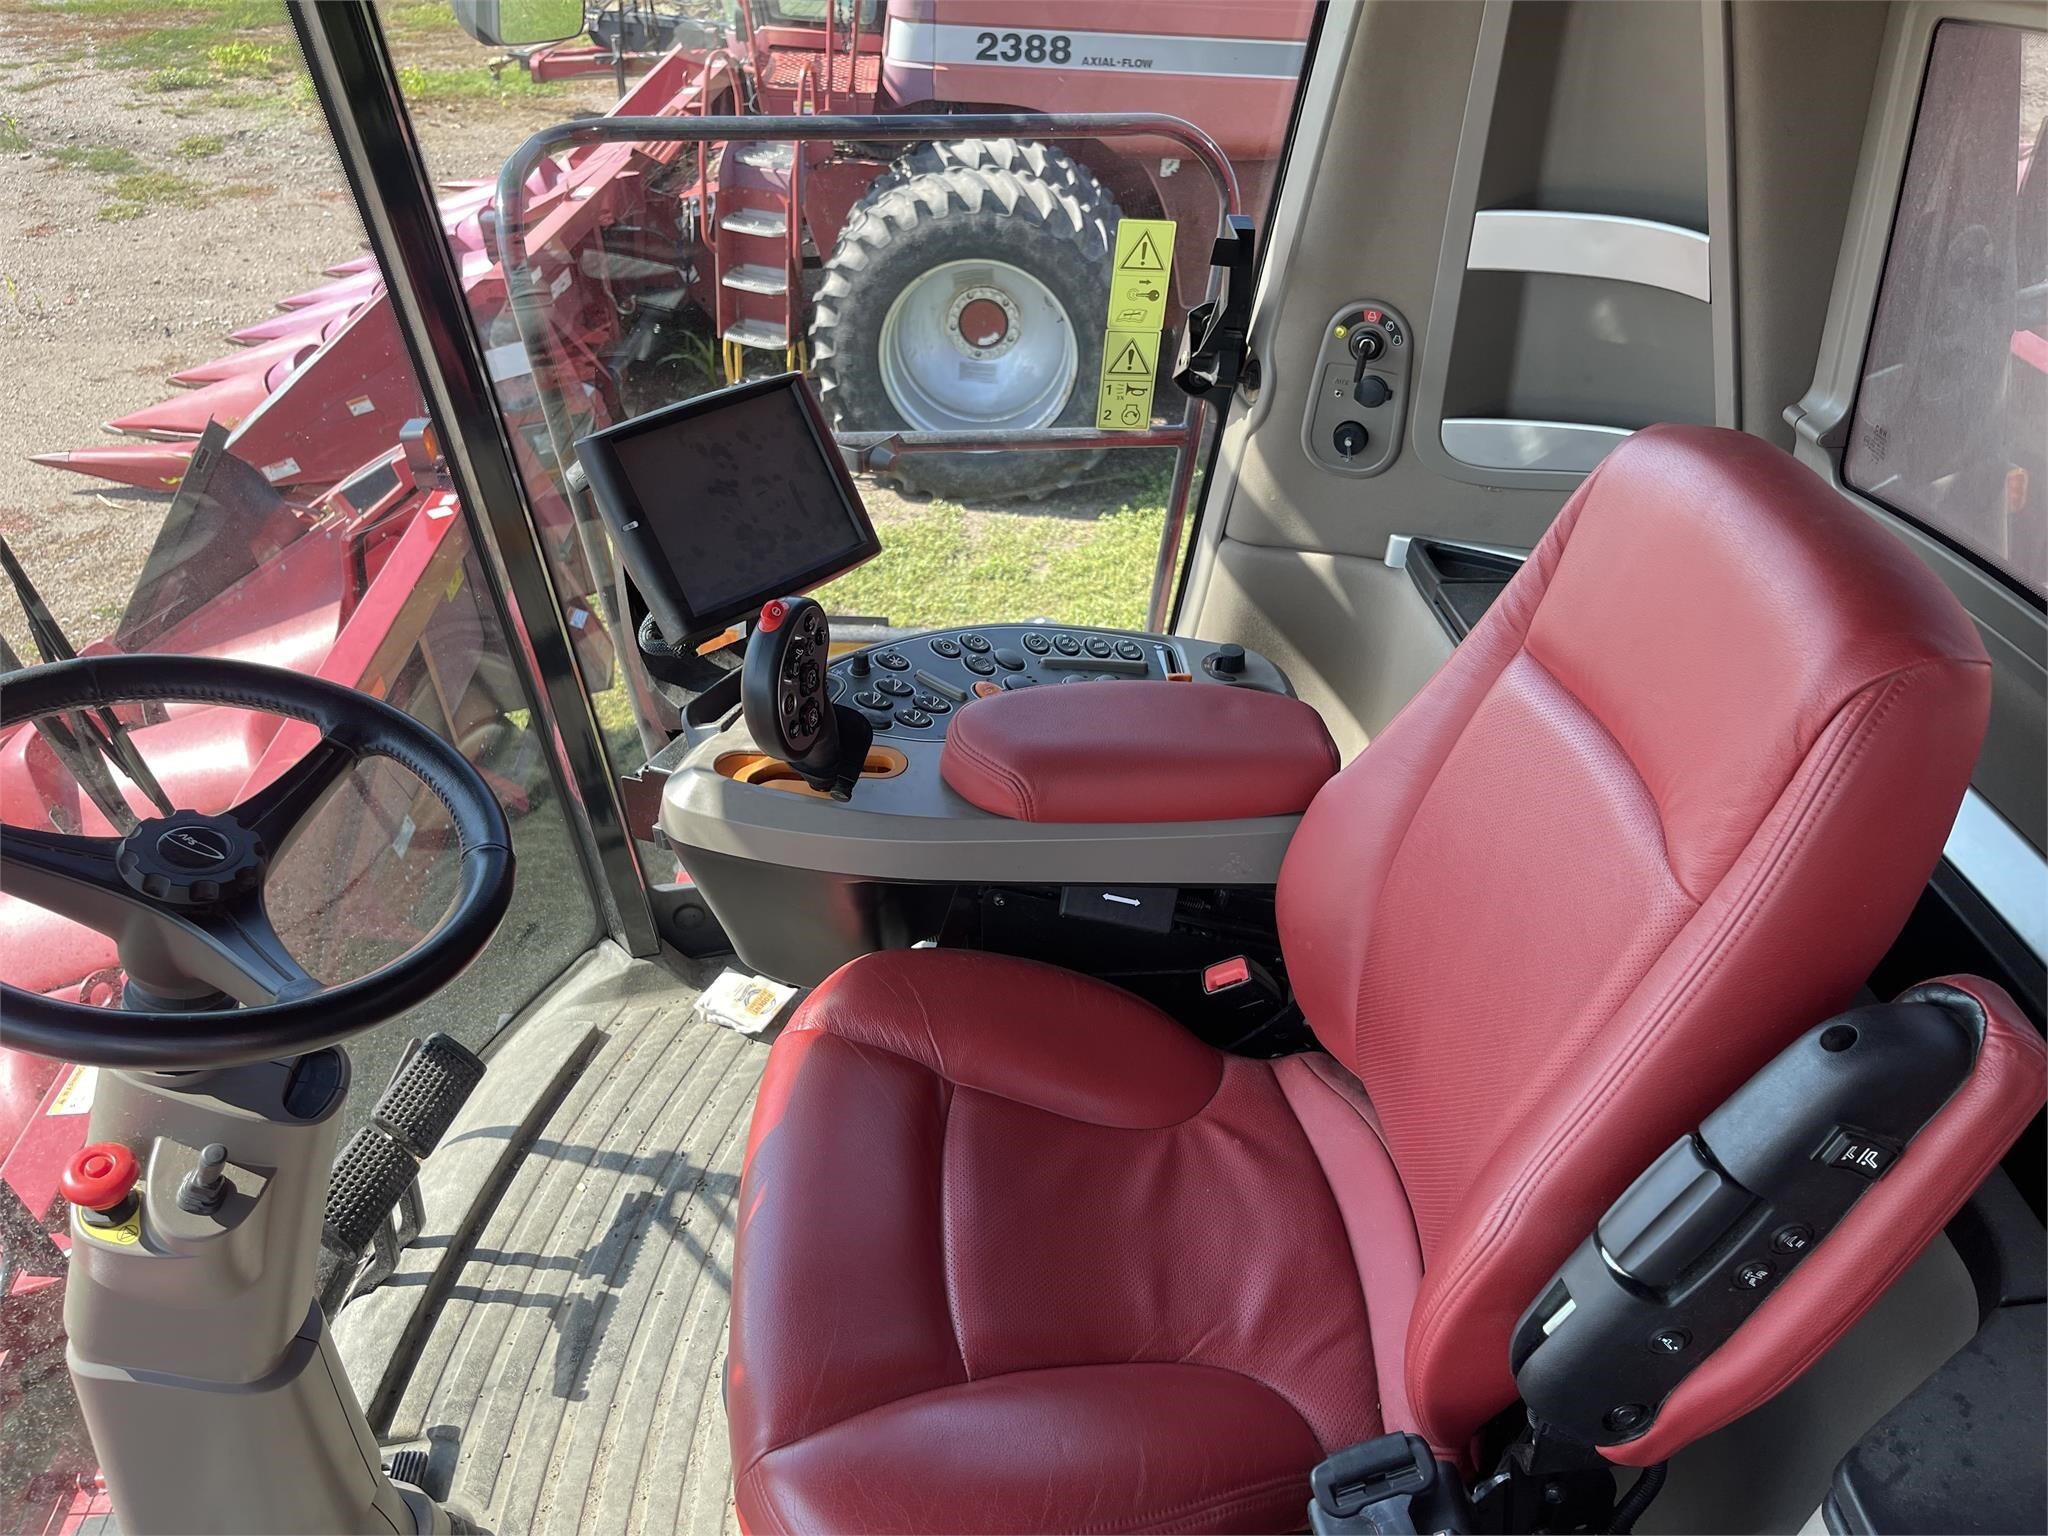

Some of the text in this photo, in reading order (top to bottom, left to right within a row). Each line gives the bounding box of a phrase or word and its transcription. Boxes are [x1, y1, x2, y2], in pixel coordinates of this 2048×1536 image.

[976, 32, 1071, 64] 2388
[1081, 56, 1153, 68] AXIAL-FLOW
[1106, 384, 1112, 395] 1
[1103, 409, 1112, 421] 2
